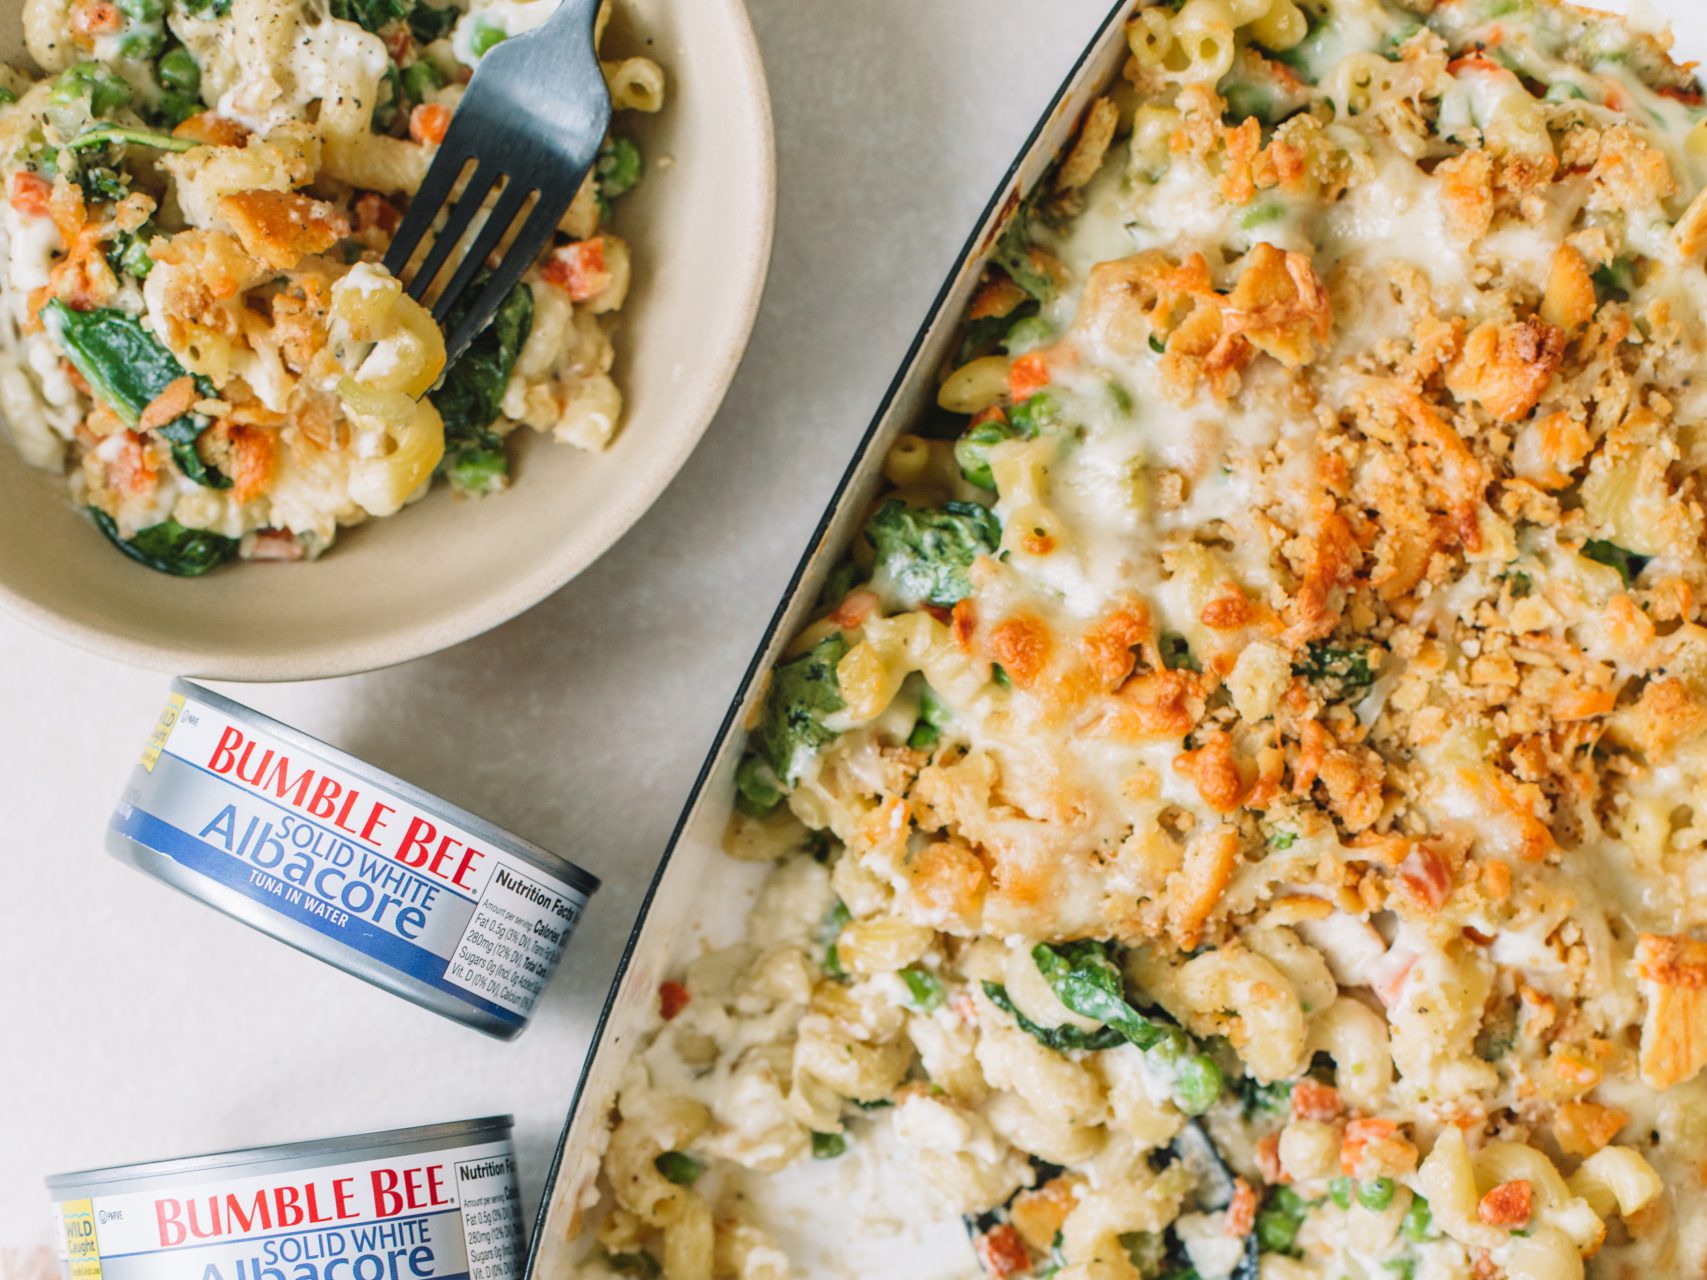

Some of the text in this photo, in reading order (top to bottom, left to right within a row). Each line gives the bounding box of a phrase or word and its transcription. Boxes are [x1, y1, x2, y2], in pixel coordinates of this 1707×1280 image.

[207, 725, 396, 846] BUMBLE
[198, 803, 427, 940] Albacore
[275, 815, 440, 911] SOLID WHITE
[250, 869, 349, 928] TUNA IN WATER
[495, 869, 552, 909] Nutrition
[551, 899, 574, 923] Facts
[475, 913, 490, 928] Fat
[489, 919, 506, 939] 0.5g
[482, 899, 507, 918] Amount
[505, 911, 517, 923] per
[533, 920, 560, 944] Calories
[466, 929, 494, 954] 280mg
[451, 962, 464, 979] Vit.
[464, 969, 474, 982] D
[472, 974, 488, 989] (0%
[459, 946, 487, 968] Sugars
[485, 959, 497, 976] 0g
[460, 1160, 505, 1181] Nutrition
[155, 1177, 360, 1247] BUMBLE
[465, 1213, 477, 1226] Fat
[263, 1218, 432, 1265] SOLID WHITE
[467, 1230, 491, 1245] 280mg
[470, 1249, 494, 1264] Sugars
[485, 1265, 491, 1278] D
